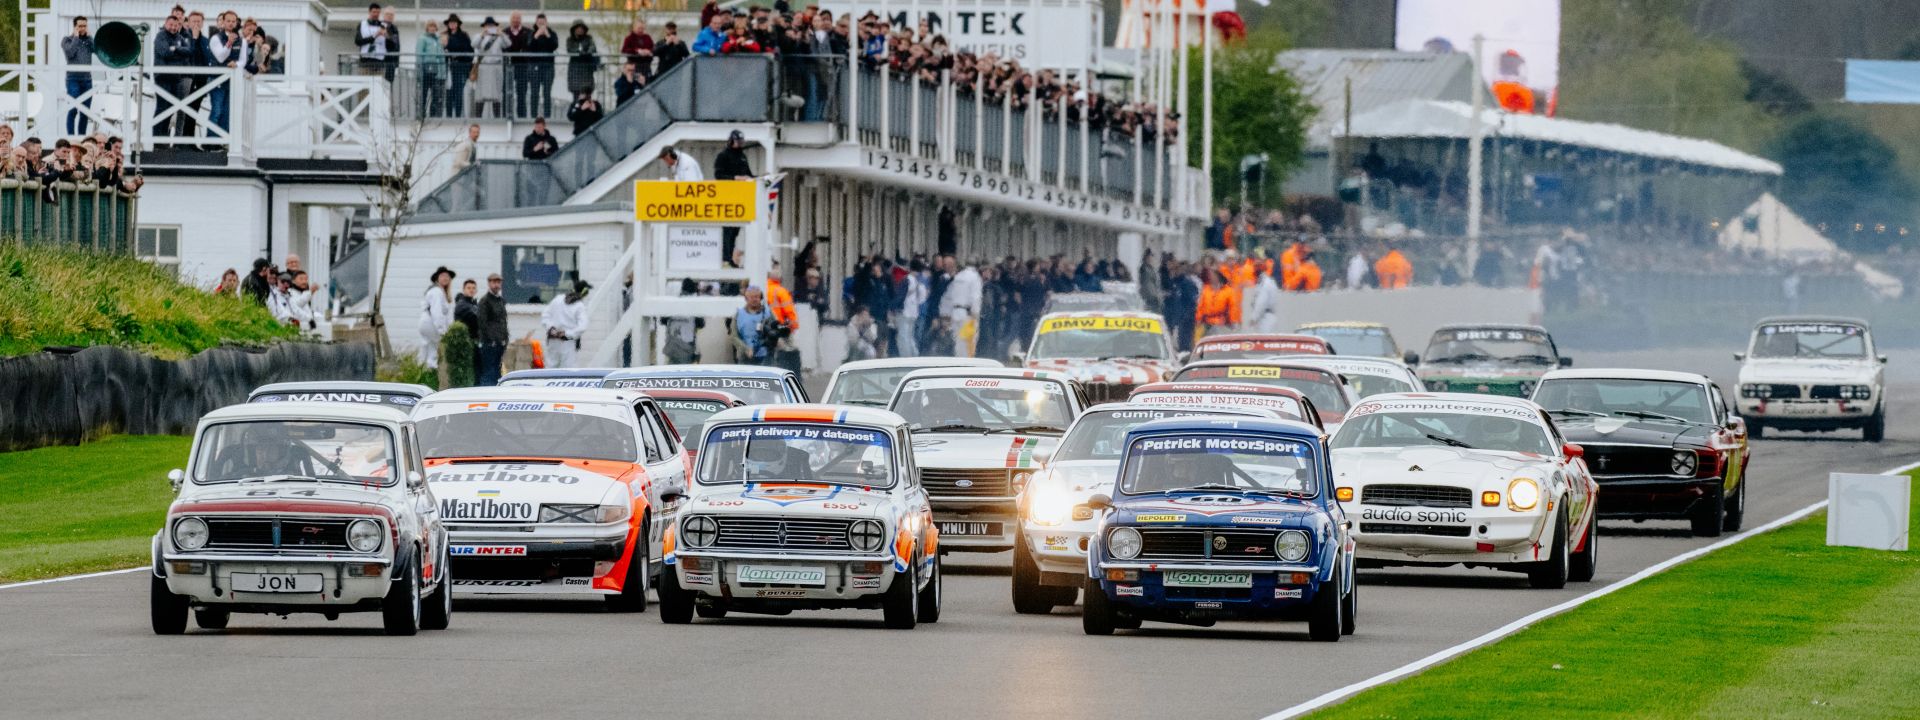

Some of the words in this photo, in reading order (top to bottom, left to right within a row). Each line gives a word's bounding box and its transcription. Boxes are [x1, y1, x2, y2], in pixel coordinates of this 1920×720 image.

[886, 11, 1026, 35] MNTEX
[675, 184, 717, 198] LAPS
[646, 203, 746, 218] COMPLETED
[1052, 320, 1096, 330] BMW
[1104, 320, 1151, 330] LUIGI
[1779, 325, 1818, 333] Leyland
[1819, 325, 1843, 334] Cars
[1231, 369, 1278, 377] LUIGI
[1350, 365, 1392, 374] CENTRE
[680, 378, 718, 388] THEN
[722, 379, 771, 391] DECIDE
[964, 379, 1000, 388] Castrol
[287, 394, 382, 403] MANNS
[1143, 395, 1203, 404] EUROPEAN
[1210, 396, 1286, 409] UNIVERSITY
[496, 402, 545, 411] Castrol
[665, 401, 717, 412] RACING
[1383, 403, 1537, 419] computerservice
[1111, 410, 1164, 420] eumig
[721, 428, 750, 440] parts
[755, 427, 801, 438] delivery
[805, 428, 820, 439] by
[823, 429, 875, 442] datapost
[1143, 438, 1201, 450] Patrick
[1205, 439, 1300, 454] MotorSport
[440, 498, 532, 519] Marlboro
[823, 502, 859, 510] ESSO
[1362, 506, 1412, 522] audio
[1417, 508, 1467, 523] sonic
[686, 575, 713, 583] CHAMPION
[740, 565, 823, 582] Longman
[1167, 571, 1247, 585] Longman
[257, 576, 296, 590] JON
[565, 578, 590, 586] Castrol
